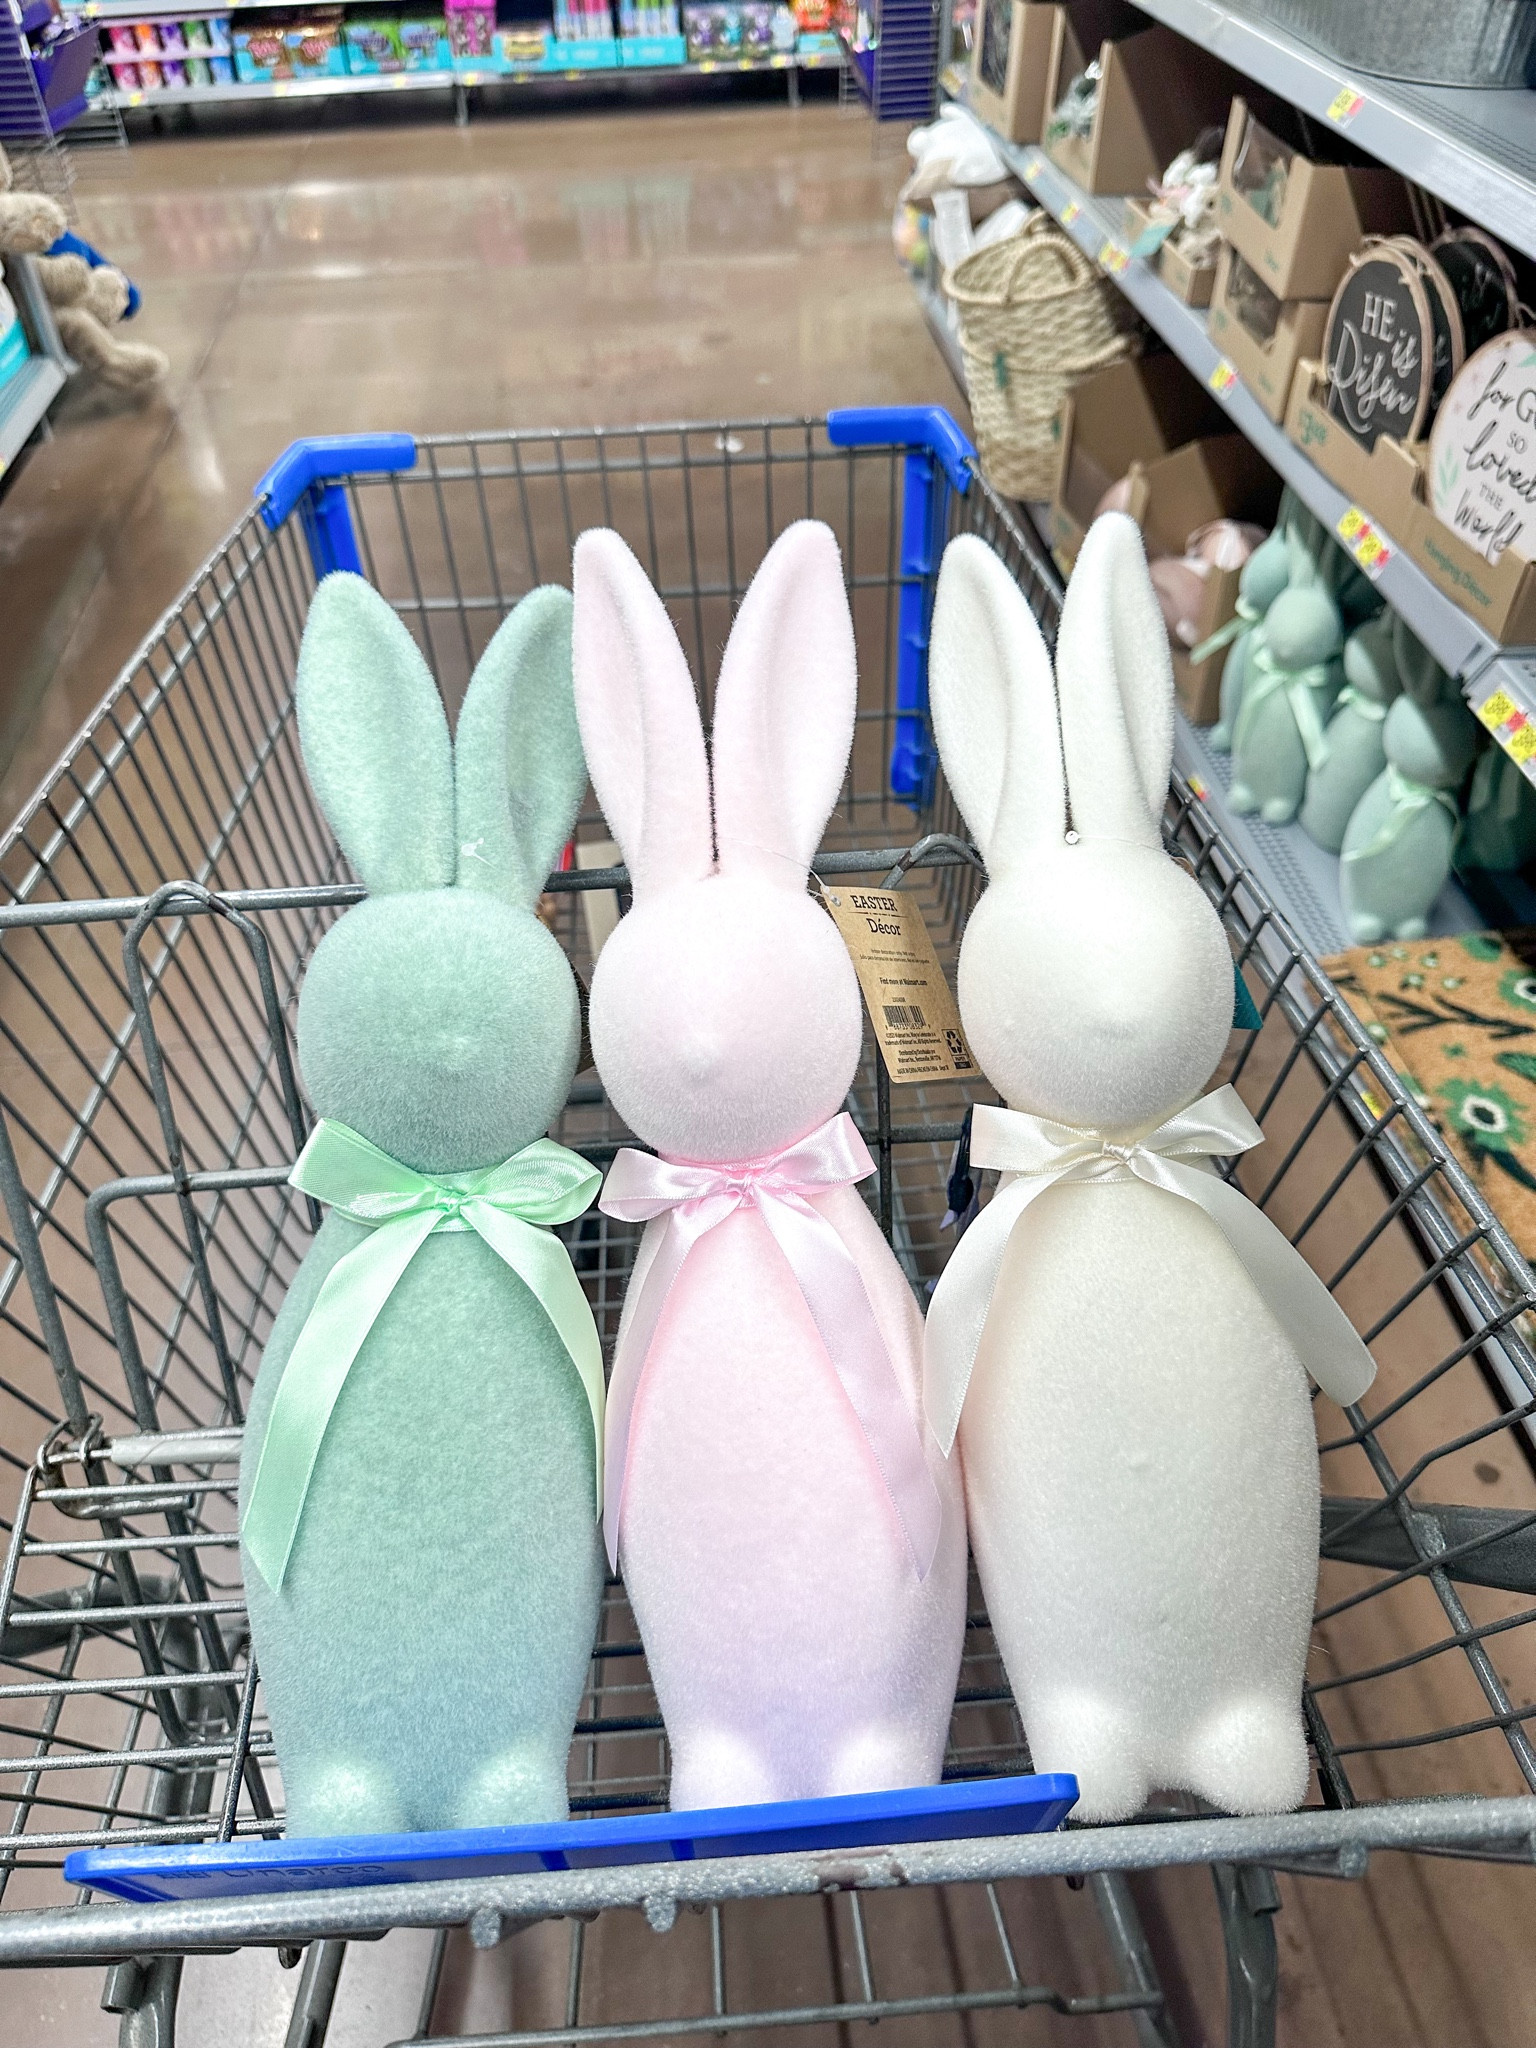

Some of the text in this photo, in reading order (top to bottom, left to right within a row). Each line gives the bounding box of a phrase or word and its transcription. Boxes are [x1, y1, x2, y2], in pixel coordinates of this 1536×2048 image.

[1361, 291, 1420, 378] HE is
[1327, 319, 1416, 434] Risen
[1467, 360, 1515, 420] for
[1454, 488, 1524, 558] World
[1480, 481, 1504, 511] THE
[850, 895, 898, 912] EASTER
[866, 917, 901, 936] Décor
